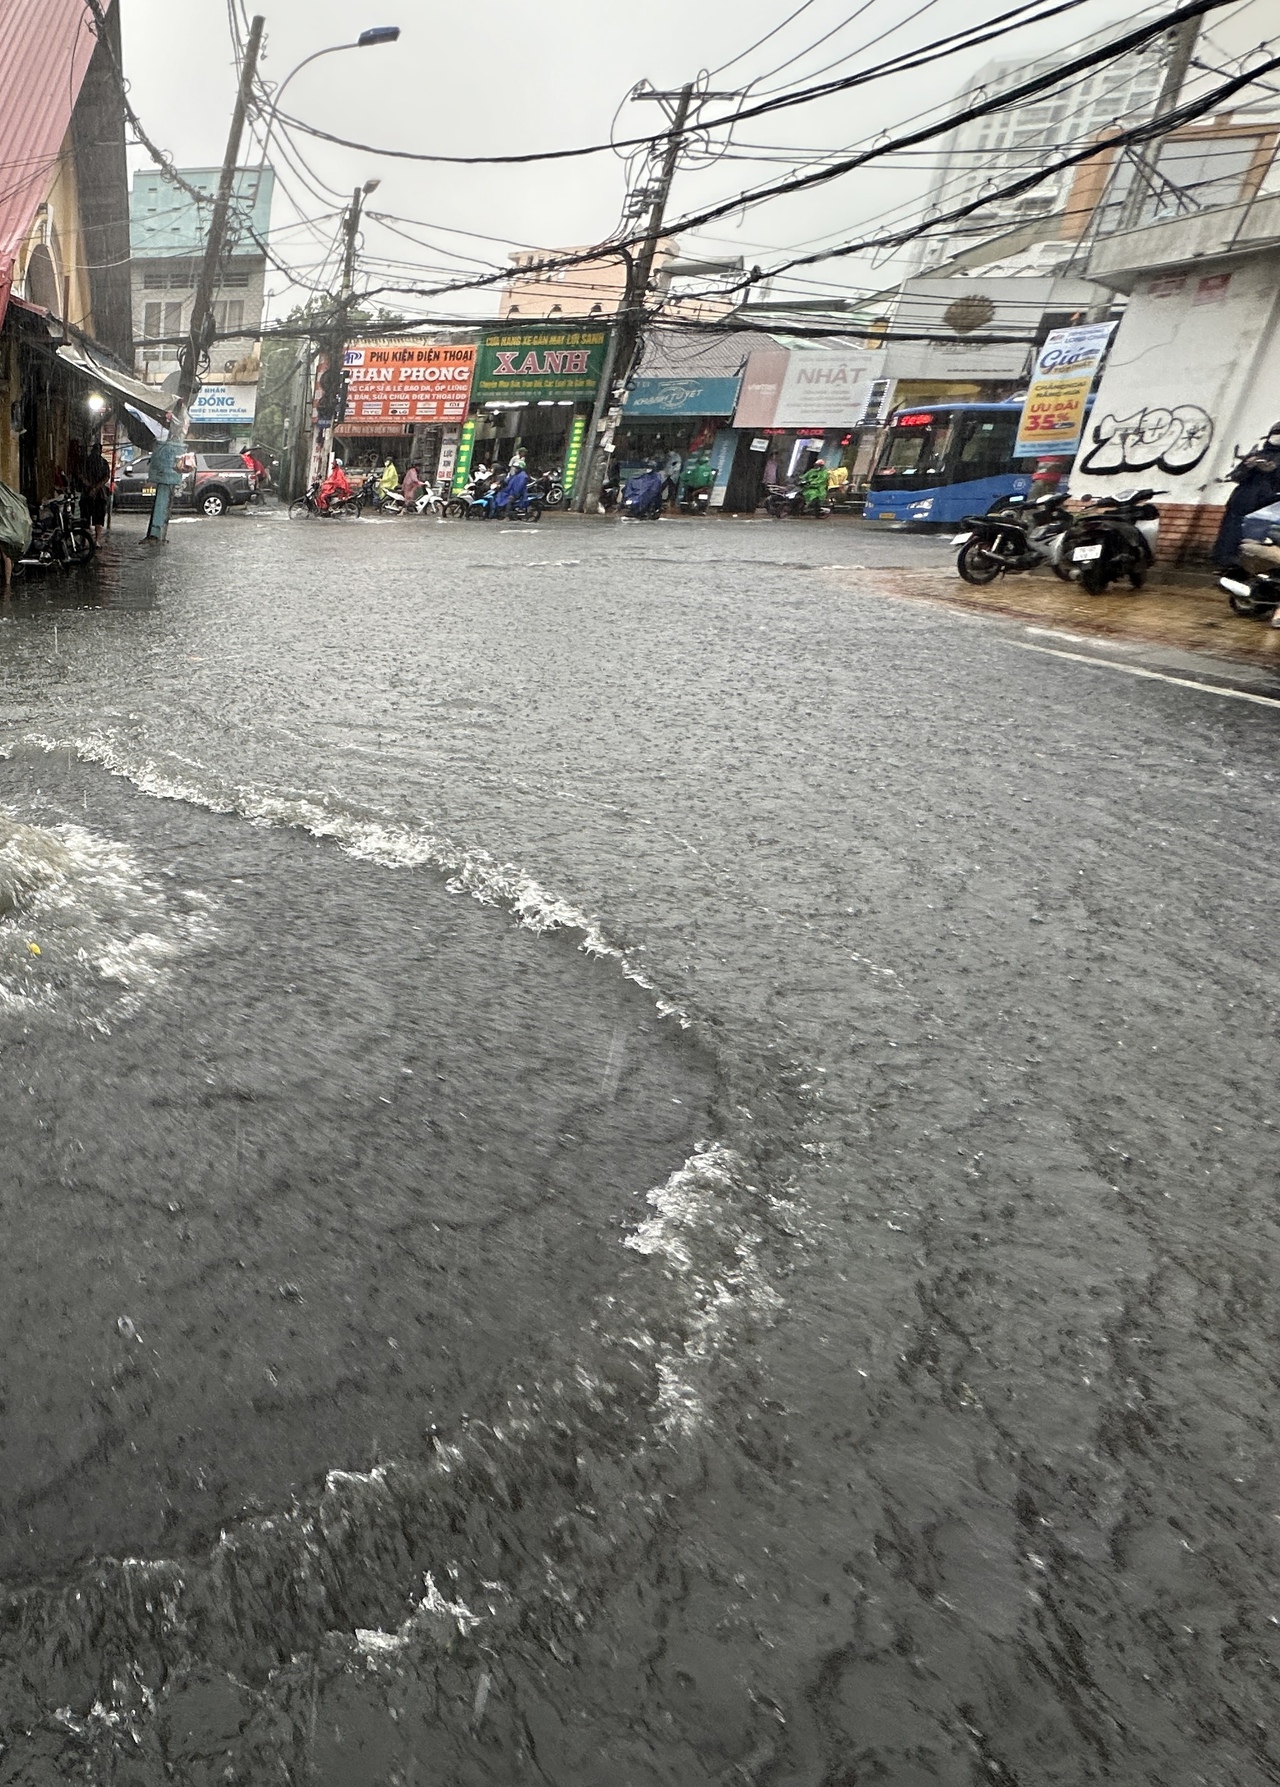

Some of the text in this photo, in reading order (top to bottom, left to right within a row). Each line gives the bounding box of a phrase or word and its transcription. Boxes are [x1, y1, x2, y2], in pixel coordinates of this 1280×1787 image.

[369, 348, 473, 365] PHỤ KIỆN ĐIỆN THOẠI
[493, 350, 591, 375] XANH
[399, 366, 470, 382] PHONG
[797, 363, 867, 387] NHẬT
